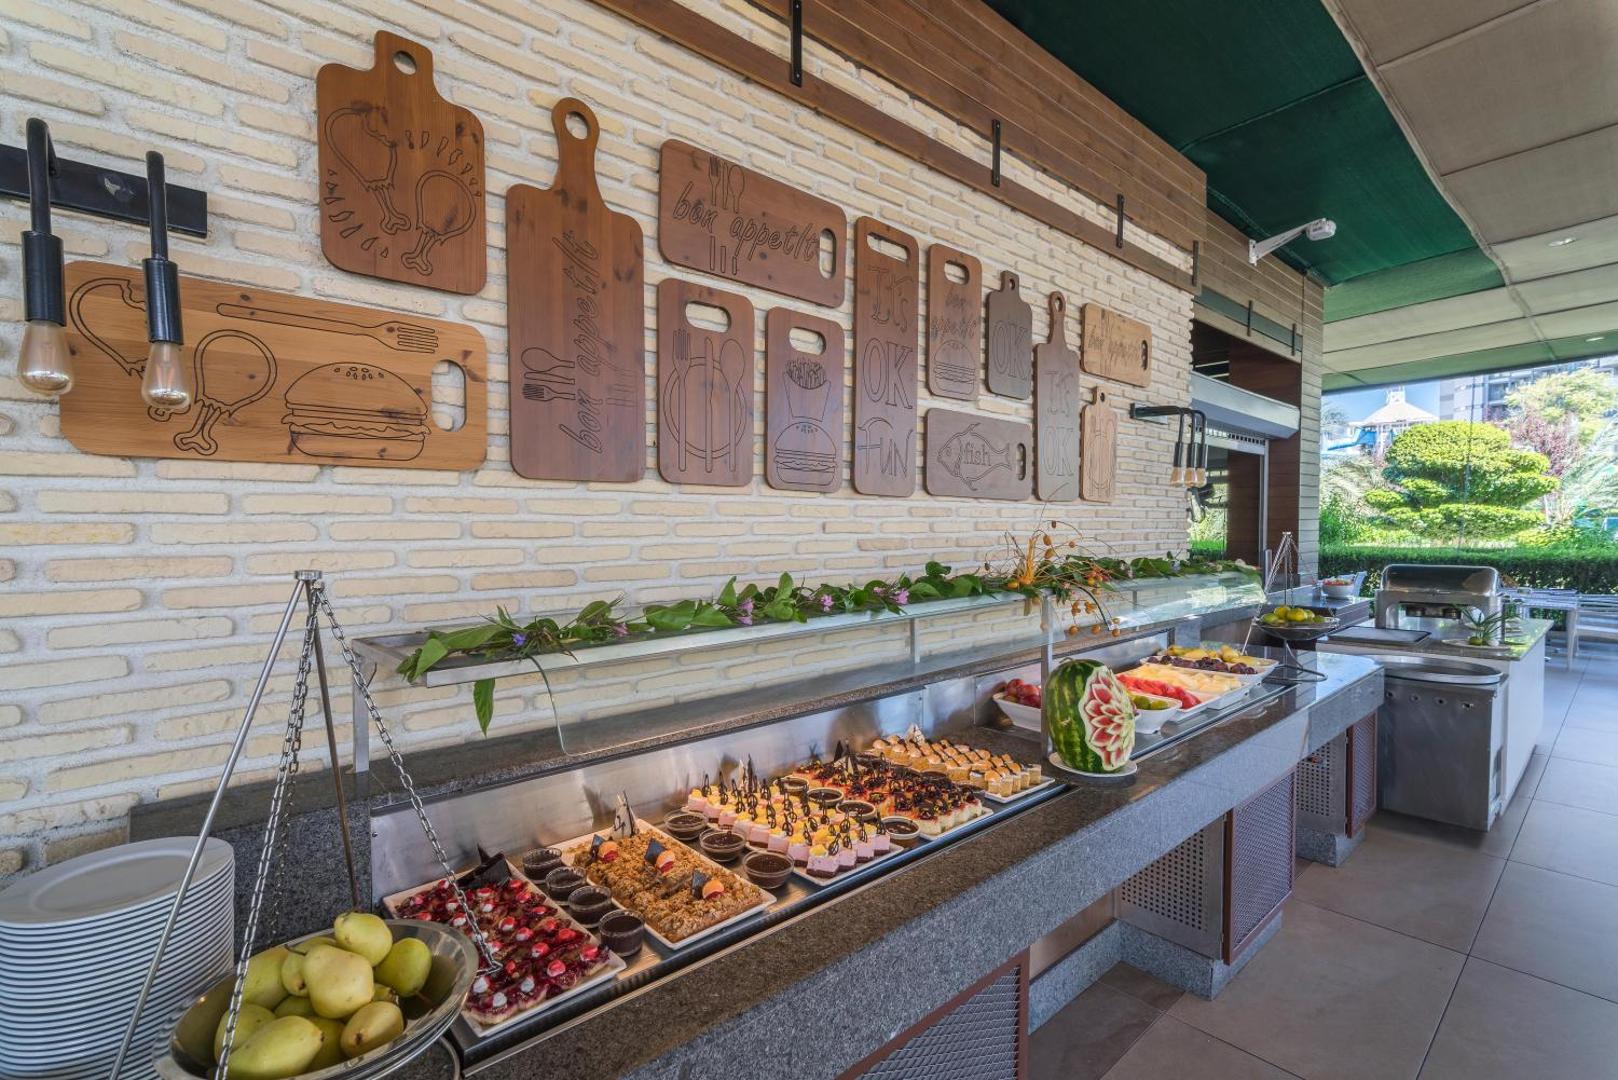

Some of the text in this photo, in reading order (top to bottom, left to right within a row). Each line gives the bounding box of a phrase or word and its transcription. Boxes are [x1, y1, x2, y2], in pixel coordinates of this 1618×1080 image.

[672, 180, 718, 234] bon
[862, 337, 914, 410] OK
[992, 320, 1028, 381] OK
[558, 389, 603, 454] bon
[963, 441, 992, 467] fish
[1043, 425, 1074, 476] OK
